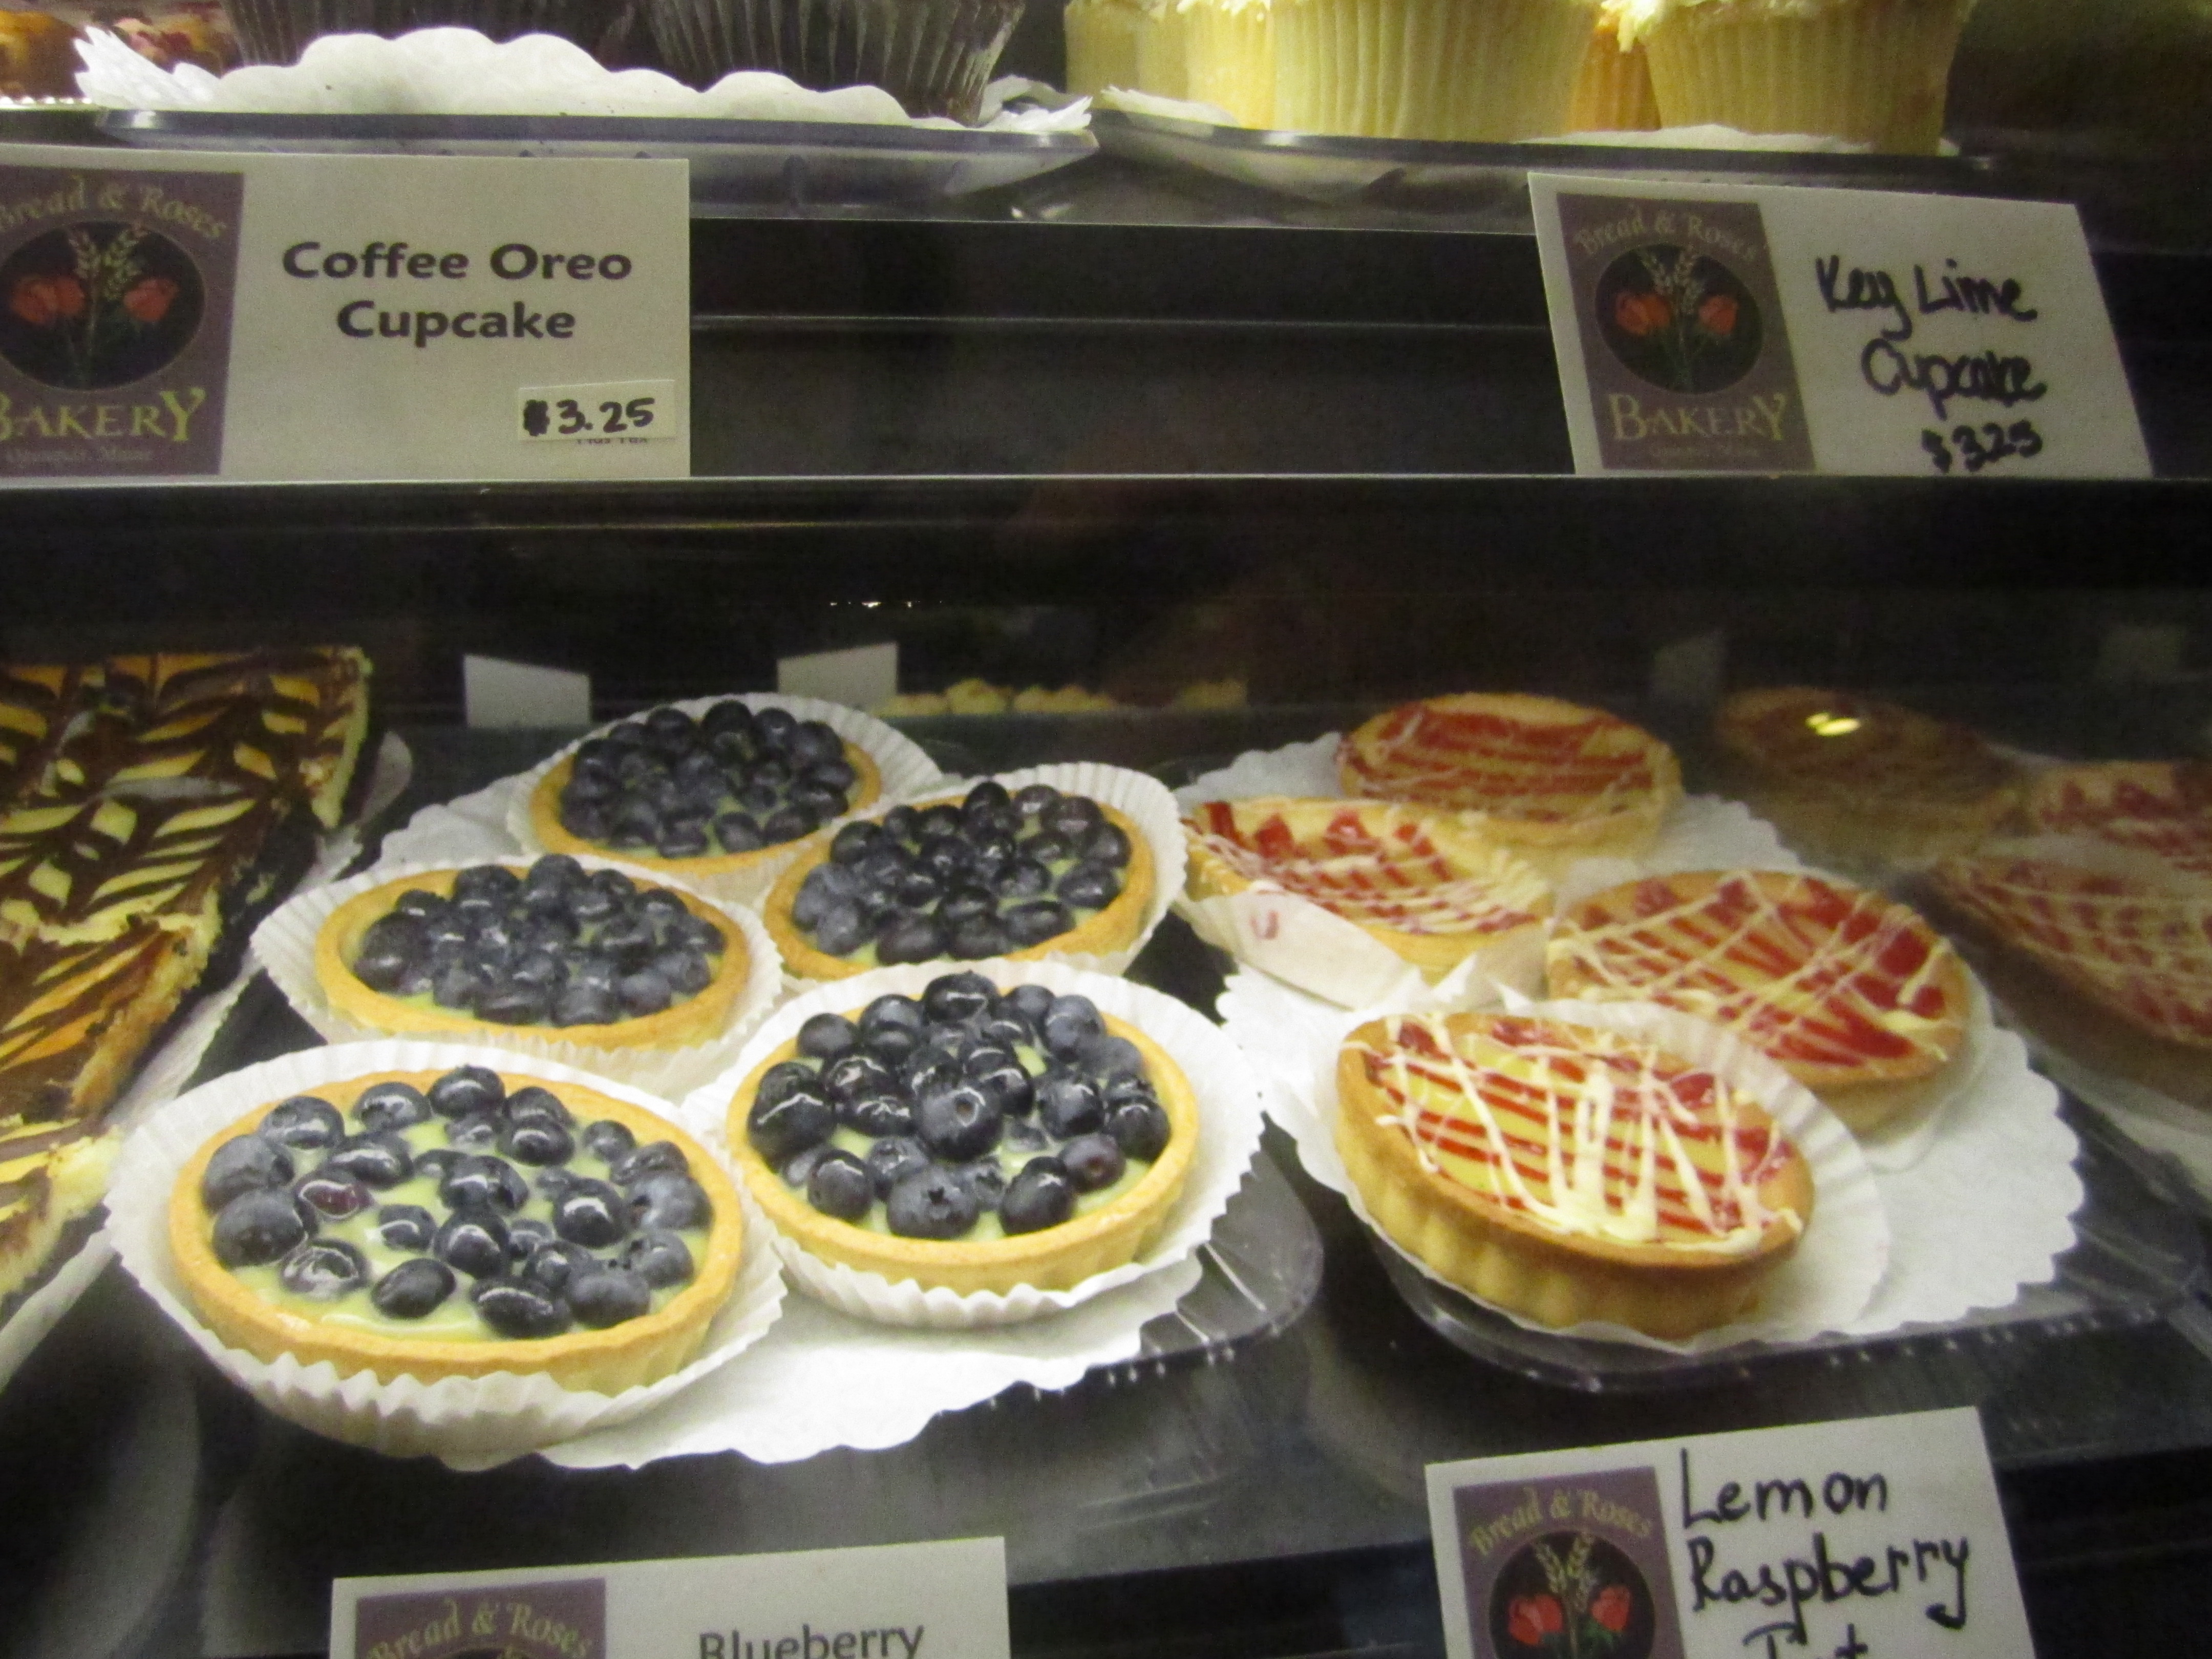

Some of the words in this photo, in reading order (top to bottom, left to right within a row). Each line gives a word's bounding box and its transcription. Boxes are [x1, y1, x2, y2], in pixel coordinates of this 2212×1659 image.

[282, 241, 470, 279] Coffee
[490, 243, 633, 281] Oreo
[336, 300, 577, 348] Cupcake
[1815, 254, 1913, 341] Key
[1914, 258, 2038, 322] Lime
[0, 387, 206, 443] AKERY
[1607, 392, 1788, 442] BAKERY
[1682, 1447, 1888, 1530] Lemon
[1687, 1531, 1970, 1646] Raspberry
[698, 1623, 925, 1659] Blueberry
